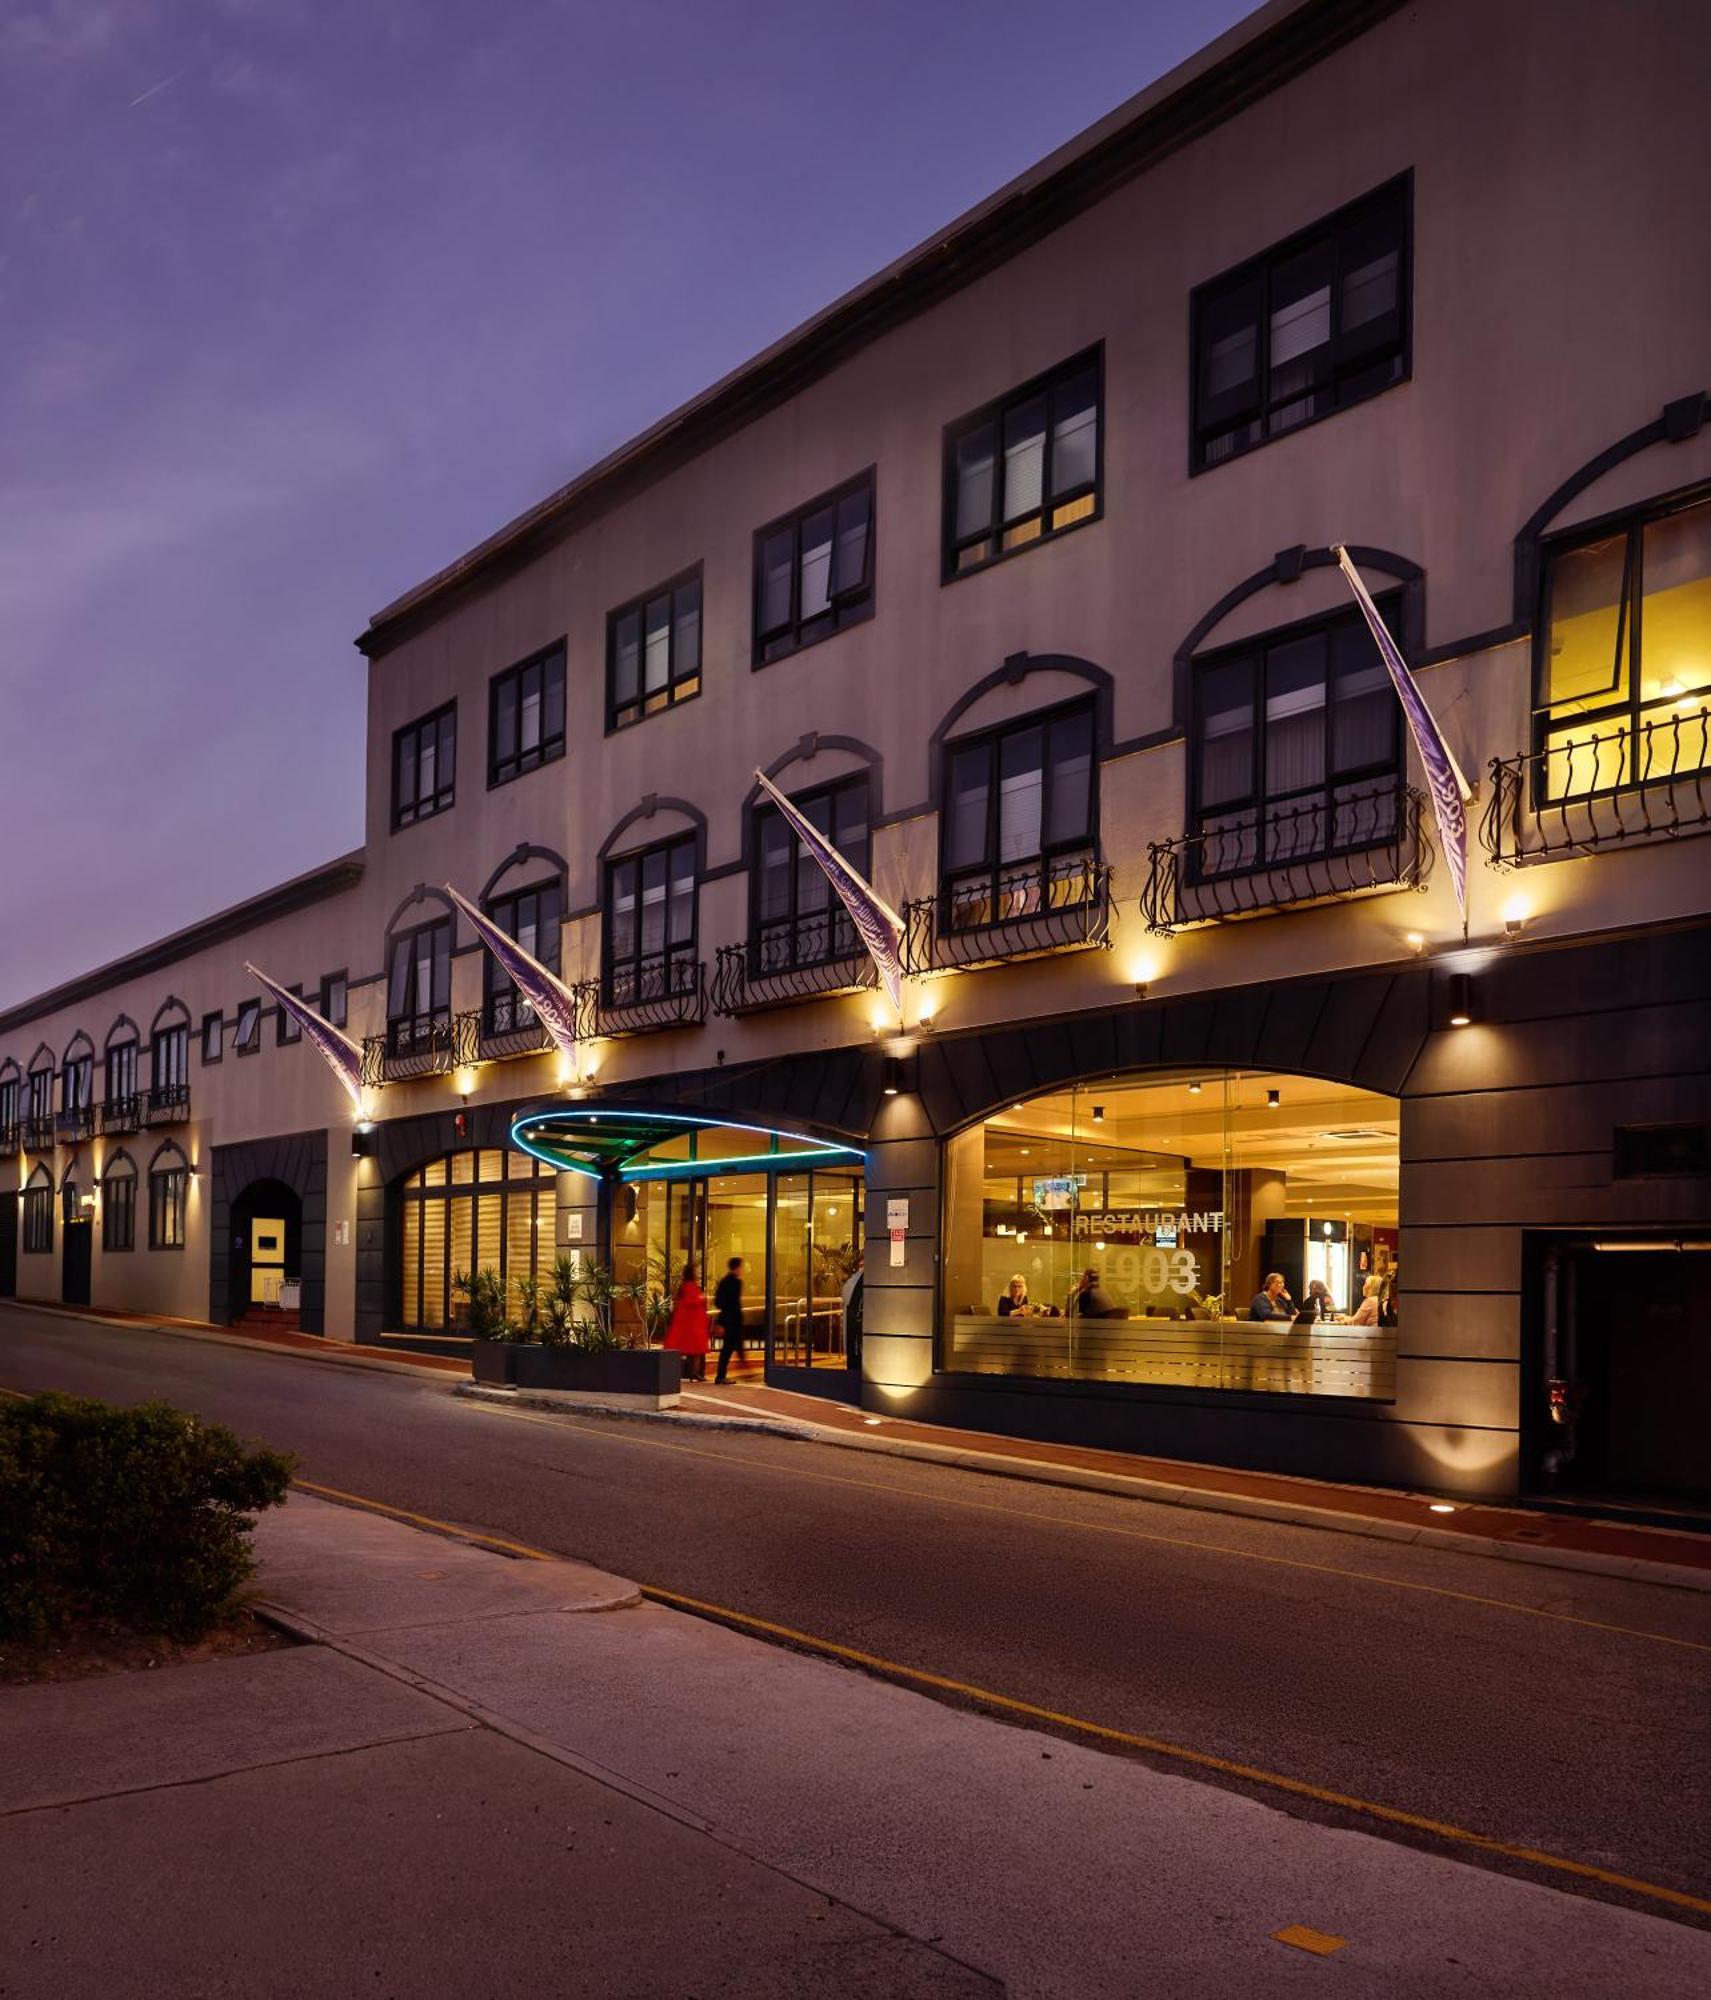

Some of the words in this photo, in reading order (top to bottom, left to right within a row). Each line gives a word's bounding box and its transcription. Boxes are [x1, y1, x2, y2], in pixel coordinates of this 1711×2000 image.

[1438, 763, 1465, 838] 1903
[1075, 1212, 1224, 1234] RESTAURANT
[1090, 1250, 1197, 1294] 1903
